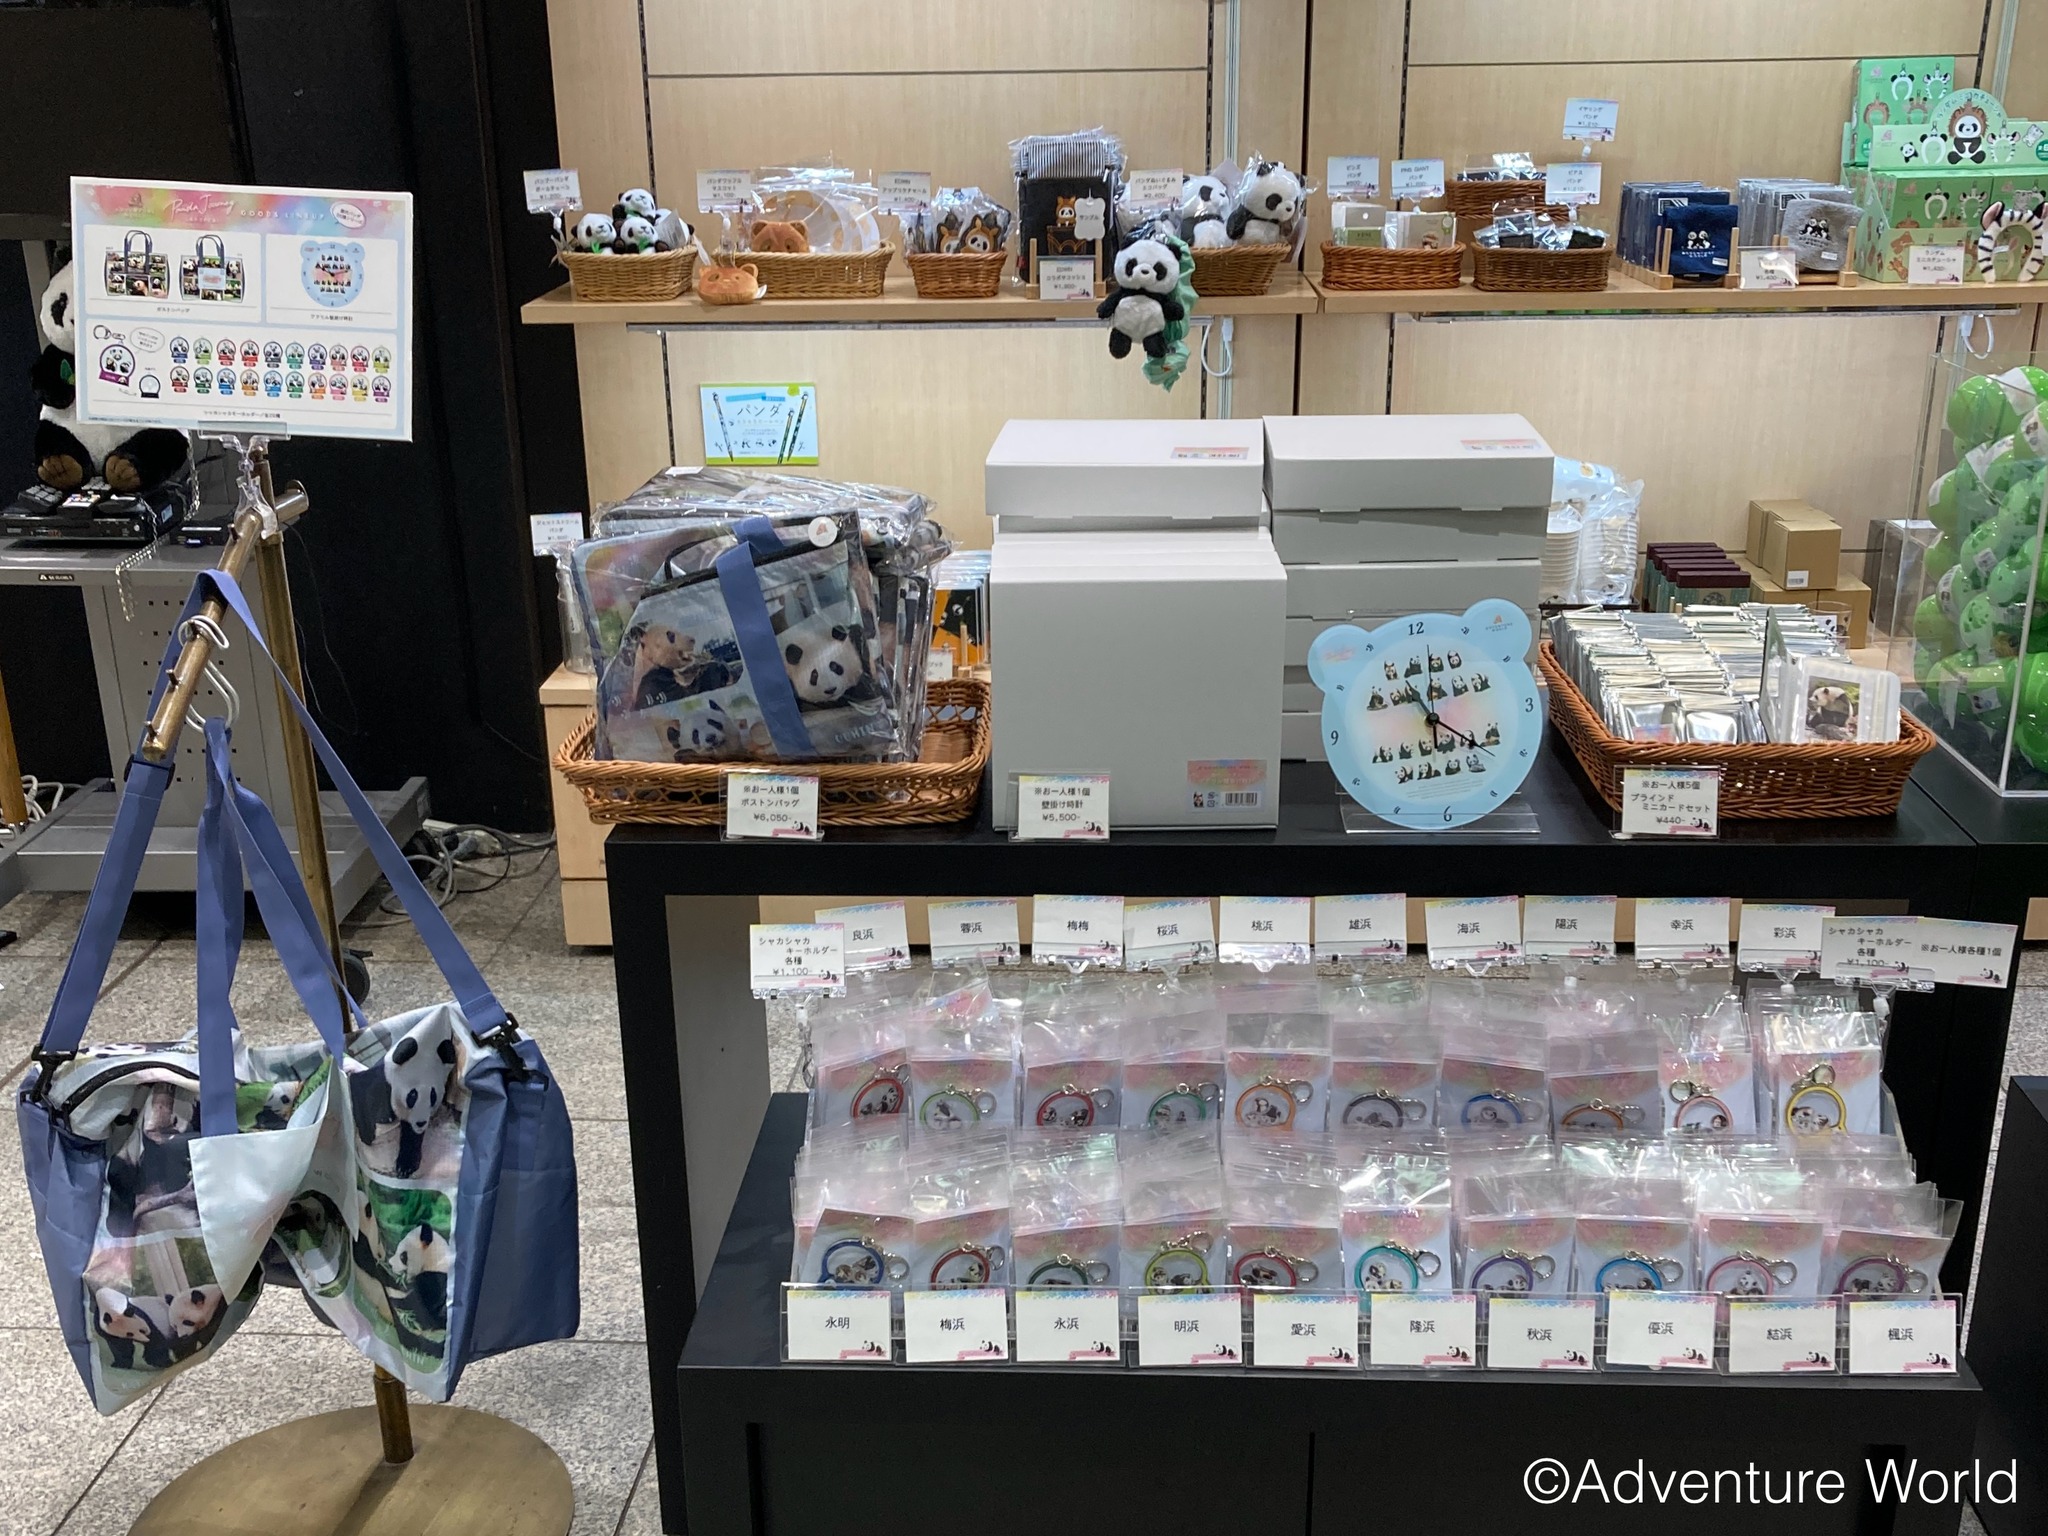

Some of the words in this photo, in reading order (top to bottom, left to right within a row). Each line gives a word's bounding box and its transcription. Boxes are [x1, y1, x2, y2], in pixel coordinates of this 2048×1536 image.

[737, 403, 782, 418] パンダ
[1407, 621, 1425, 636] 12
[1525, 697, 1534, 713] 3
[1330, 730, 1339, 746] 9
[743, 785, 799, 794] ※お一人様1個
[1034, 787, 1090, 796] ※お一人様1個
[1642, 781, 1700, 790] ※お一人様5個
[741, 798, 800, 807] ボストンバッグ
[1631, 793, 1674, 802] ブラインド
[1041, 800, 1083, 809] 壁掛け時計
[1642, 802, 1711, 813] ミニカードセット
[1443, 805, 1453, 822] 6
[1066, 919, 1089, 932] 梅梅
[1156, 923, 1179, 937] 桜浜
[1251, 919, 1273, 932] 桃浜
[1348, 918, 1371, 931] 雄浜
[1457, 921, 1480, 934] 海浜
[1555, 918, 1578, 931] 陽浜
[1670, 919, 1693, 931] 幸浜
[852, 928, 875, 941] 良浜
[1774, 927, 1797, 939] 彩浜
[1828, 927, 1884, 936] シャカシャカ
[759, 937, 810, 945] シャカシャカ
[1857, 937, 1912, 946] キーホルダー
[786, 946, 838, 955] キーホルダー
[1856, 947, 1876, 957] 各種
[1921, 943, 2002, 956] ※お一人様各種1個
[785, 956, 802, 965] 各種
[825, 1316, 850, 1330] 永明
[939, 1318, 965, 1331] 梅浜
[1054, 1317, 1079, 1330] 永浜
[1174, 1319, 1199, 1333] 明浜
[1290, 1323, 1316, 1336] 愛浜
[1410, 1320, 1435, 1333] 隆浜
[1648, 1321, 1674, 1335] 優浜
[1526, 1327, 1552, 1341] 秋浜
[1767, 1327, 1793, 1341] 結浜
[1888, 1327, 1914, 1341] 楓浜
